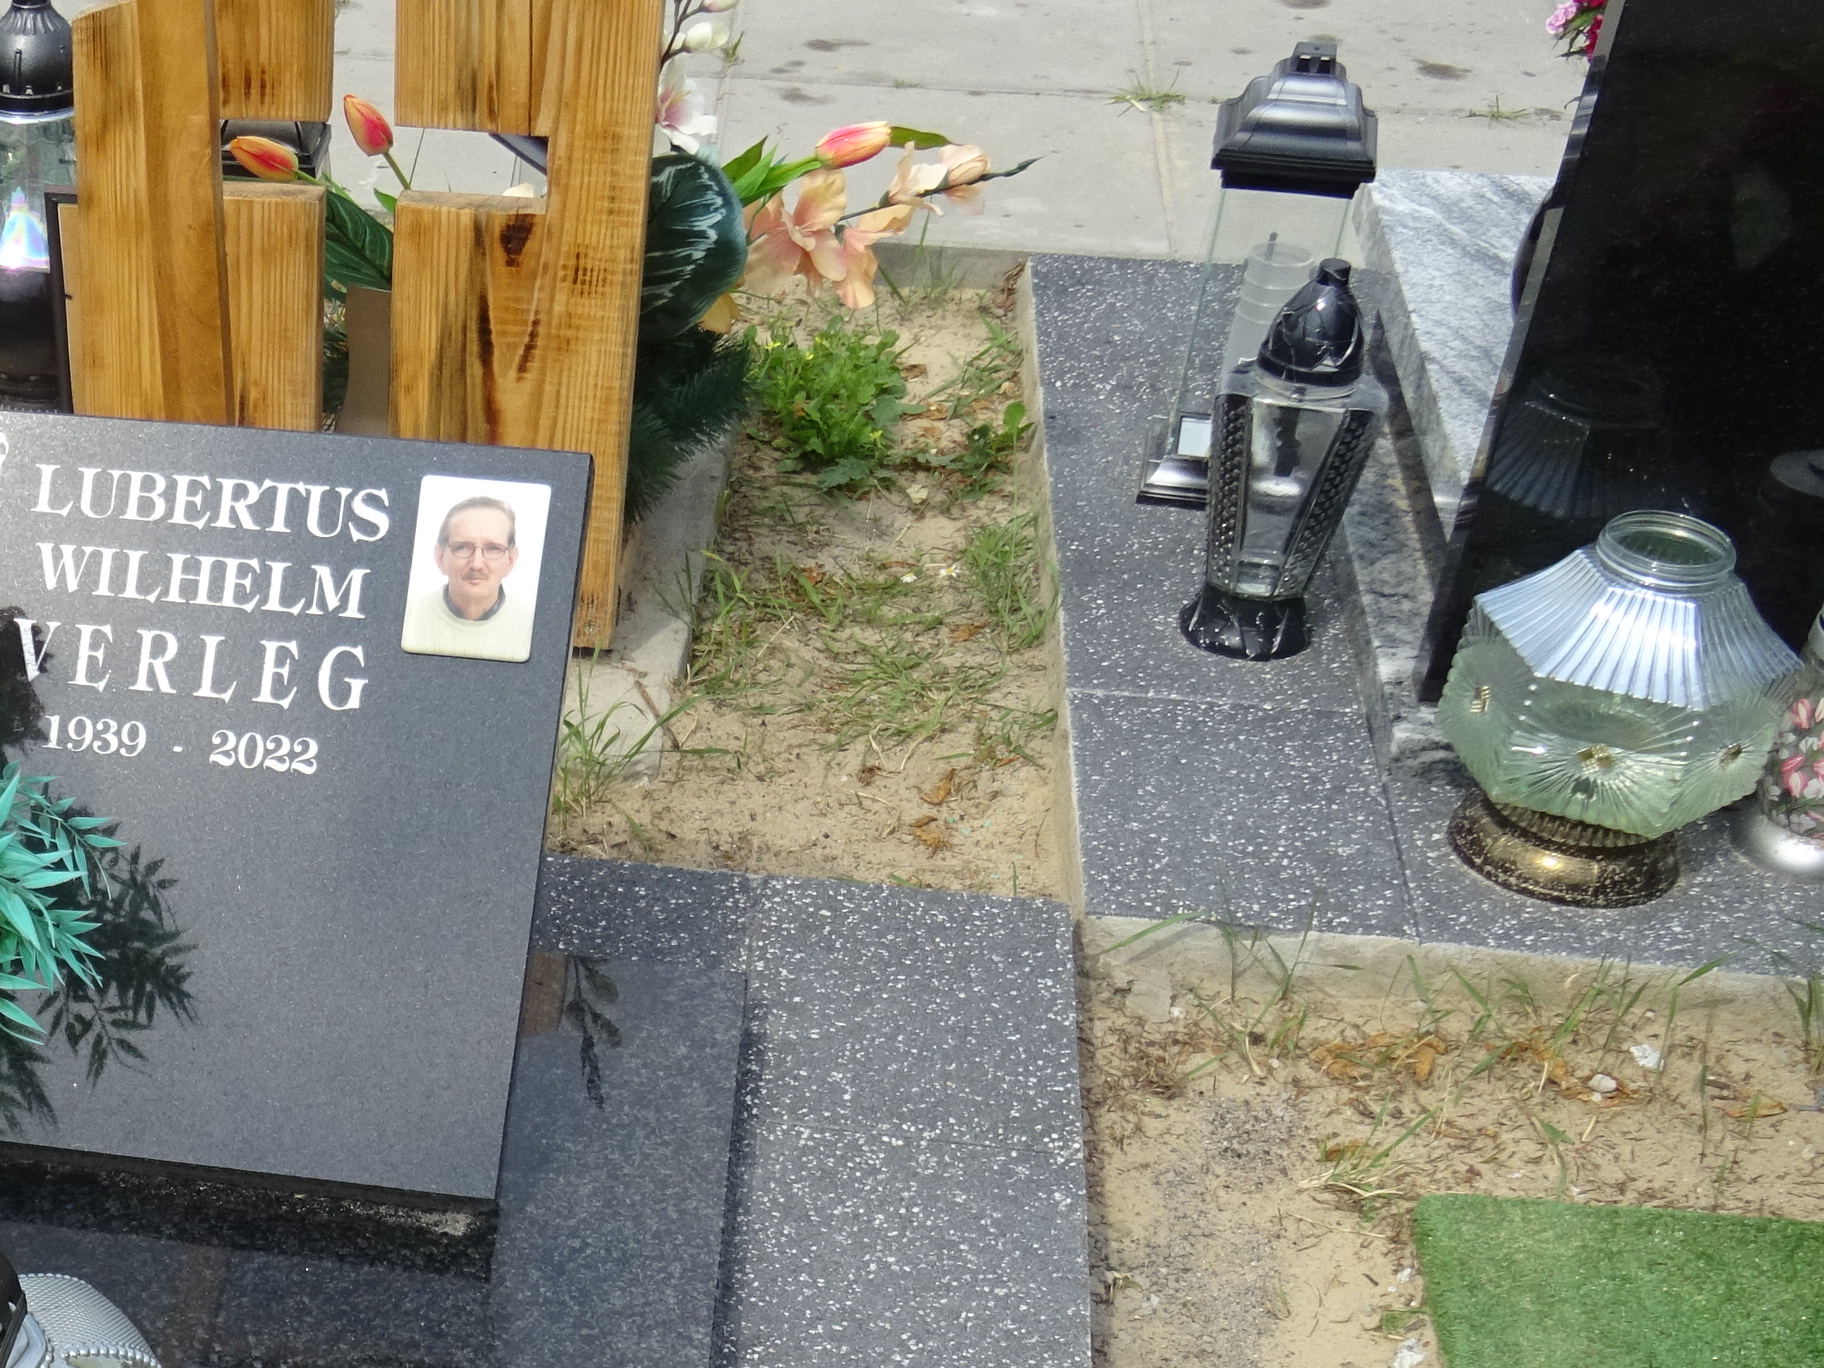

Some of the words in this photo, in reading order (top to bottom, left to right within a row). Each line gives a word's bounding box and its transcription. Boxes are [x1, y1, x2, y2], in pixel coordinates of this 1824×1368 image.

[31, 464, 390, 542] LUBERTUS
[36, 542, 371, 619] WILHELM
[13, 618, 369, 711] VERLEG
[41, 714, 147, 757] 1939
[209, 729, 319, 774] 2022
